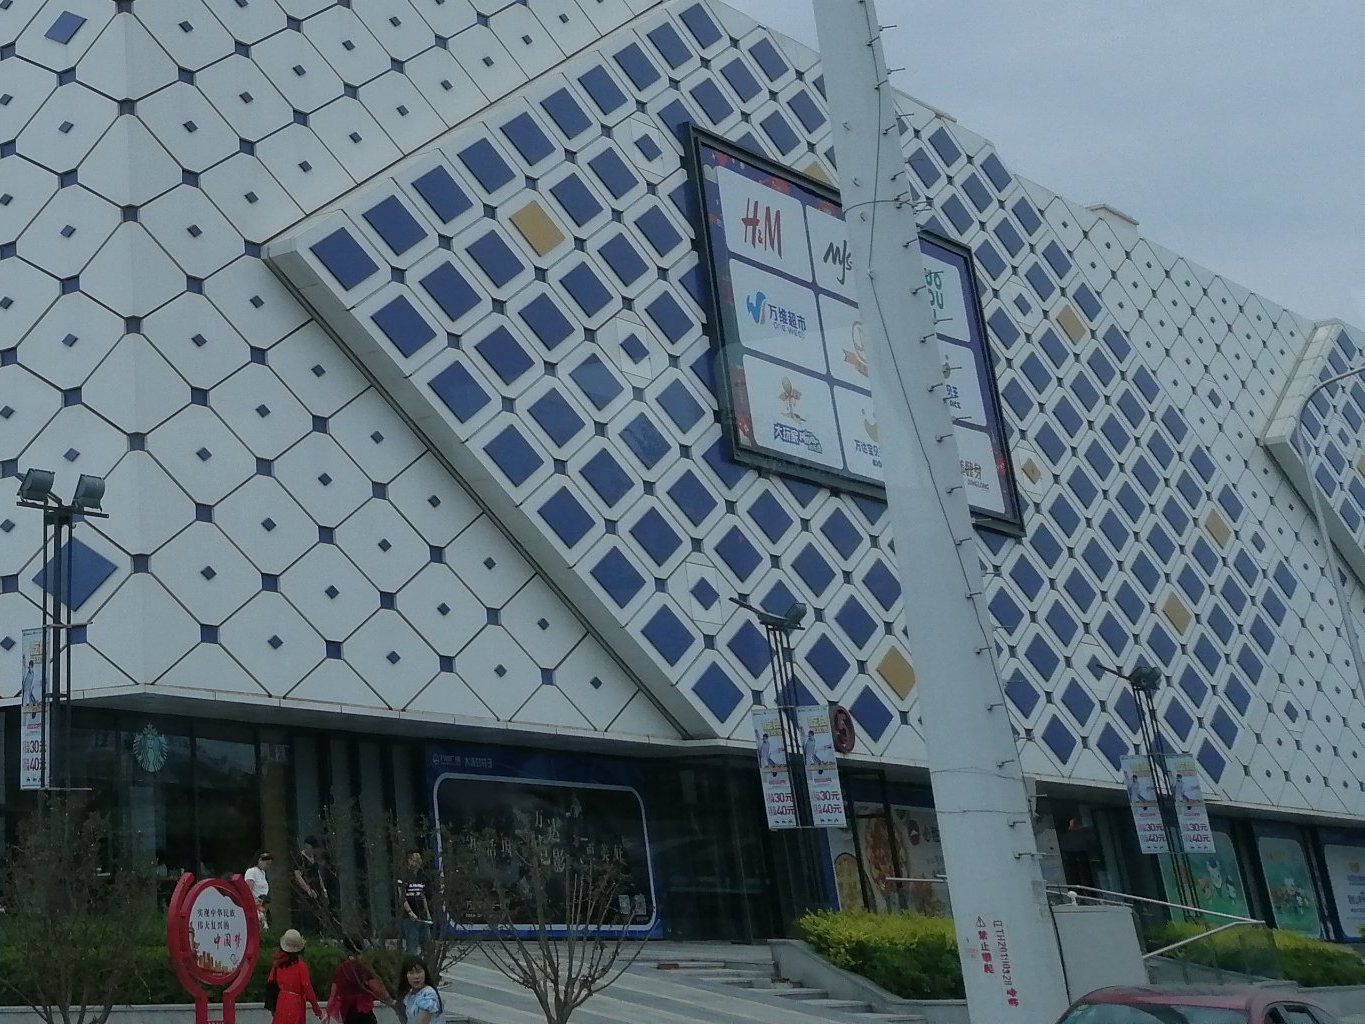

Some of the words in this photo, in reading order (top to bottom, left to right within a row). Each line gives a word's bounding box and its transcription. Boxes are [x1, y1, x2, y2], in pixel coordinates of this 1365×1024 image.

[741, 197, 783, 260] H&M
[767, 303, 807, 332] 万维超市
[214, 933, 242, 950] 中国梦
